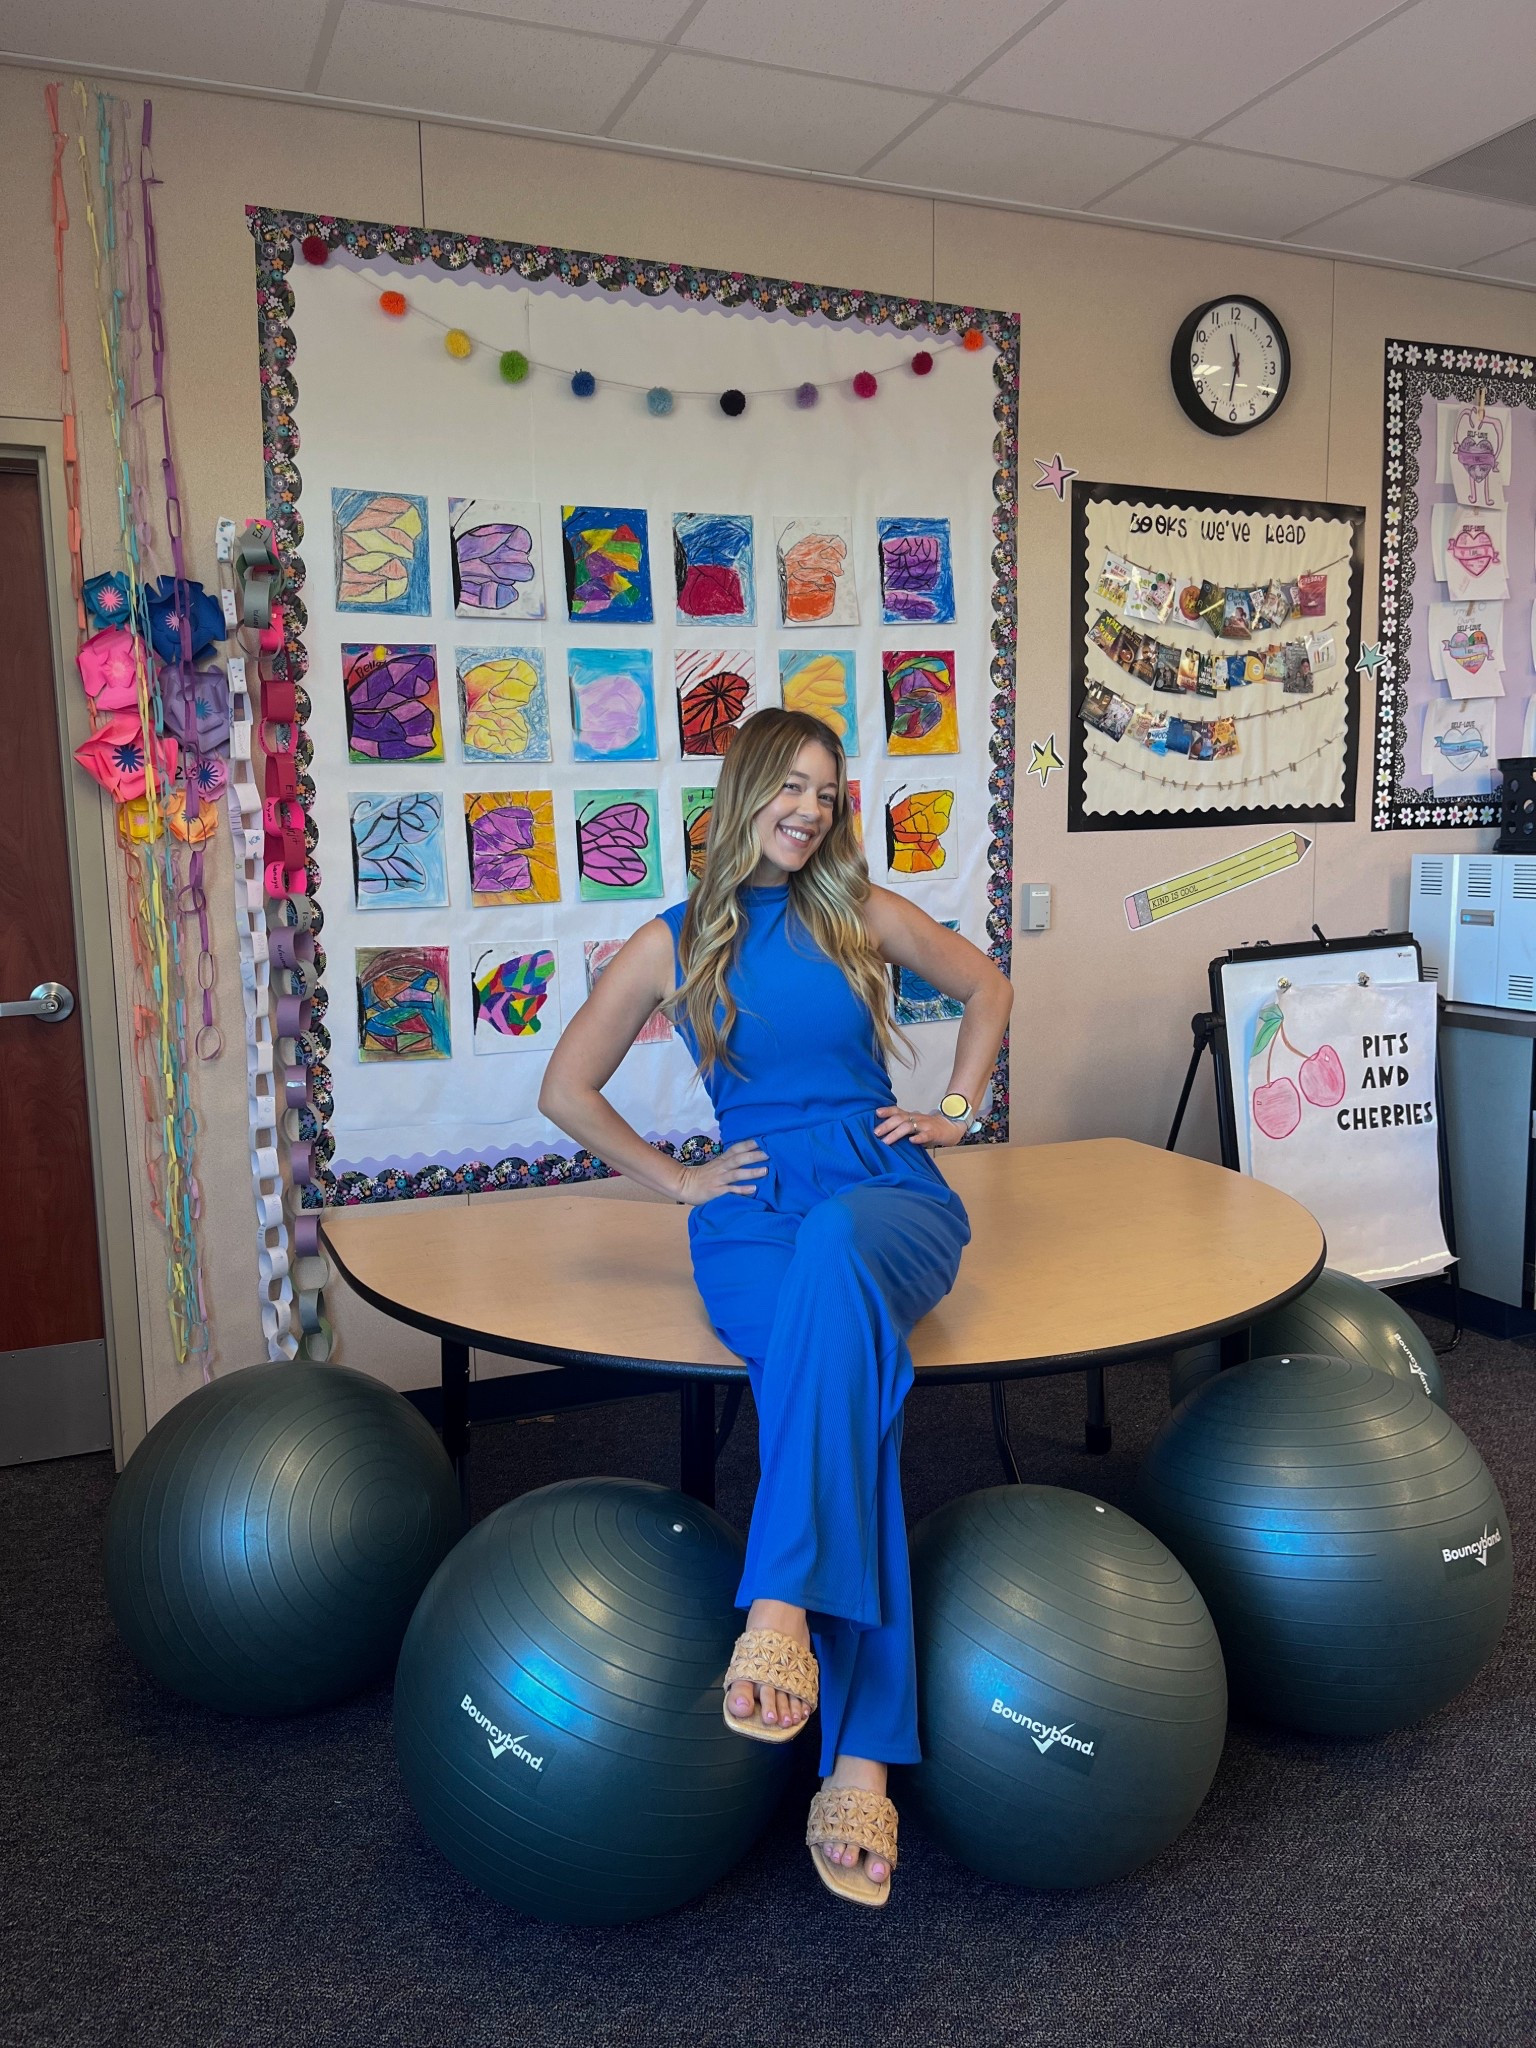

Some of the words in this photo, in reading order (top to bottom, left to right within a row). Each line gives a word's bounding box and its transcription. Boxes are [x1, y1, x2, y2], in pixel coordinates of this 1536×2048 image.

[1211, 312, 1219, 325] 11
[1231, 307, 1241, 321] 12
[1196, 331, 1206, 343] 10
[1266, 335, 1273, 348] 2
[1191, 354, 1200, 366] 9
[1269, 361, 1276, 375] 3
[1196, 380, 1204, 395] 8
[1262, 384, 1270, 398] 4
[1211, 401, 1217, 414] 7
[1229, 408, 1237, 421] 6
[1249, 404, 1256, 416] 5
[1457, 624, 1481, 632] SELF-LOVE
[1451, 721, 1475, 729] SELF-LOVE
[1152, 895, 1170, 908] KIND
[1171, 891, 1179, 900] IS
[1180, 885, 1199, 896] COOL
[1362, 1032, 1408, 1058] PITS
[1361, 1066, 1409, 1089] AND
[1337, 1101, 1433, 1130] CHERRIES
[1442, 1527, 1501, 1563] Bouncyband
[461, 1694, 543, 1771] Bouncyband
[991, 1698, 1094, 1756] Bouncyband
